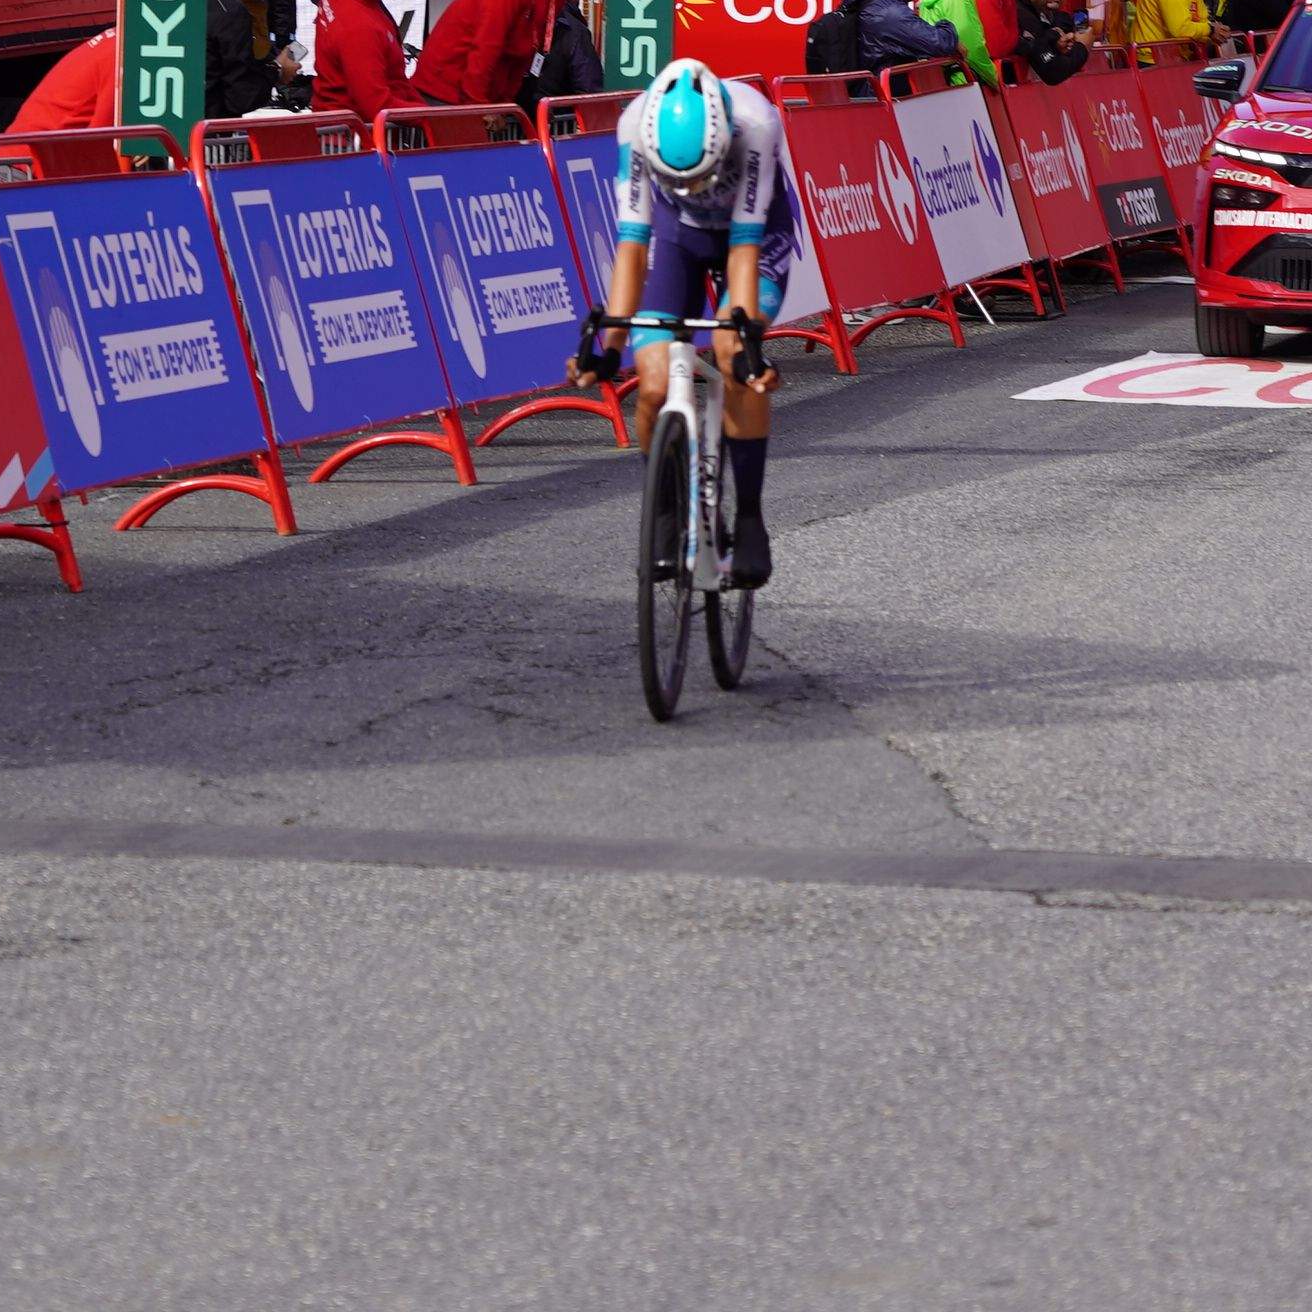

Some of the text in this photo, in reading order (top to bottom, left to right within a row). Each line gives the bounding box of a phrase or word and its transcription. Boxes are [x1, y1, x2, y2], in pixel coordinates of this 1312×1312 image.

[1099, 98, 1144, 153] Cofidis
[912, 144, 981, 221] Carrefour
[1019, 129, 1072, 198] Carrefour
[284, 190, 393, 280] LOTERÍAS
[457, 175, 555, 257] LOTERÍAS
[803, 163, 882, 240] Carrefour
[1128, 185, 1163, 228] TISSOT
[72, 210, 205, 309] LOTERÍAS
[321, 305, 405, 349] CON EL DEPORTE
[490, 278, 569, 319] CON EL DEPORTE
[112, 334, 218, 385] CON EL DEPORTE
